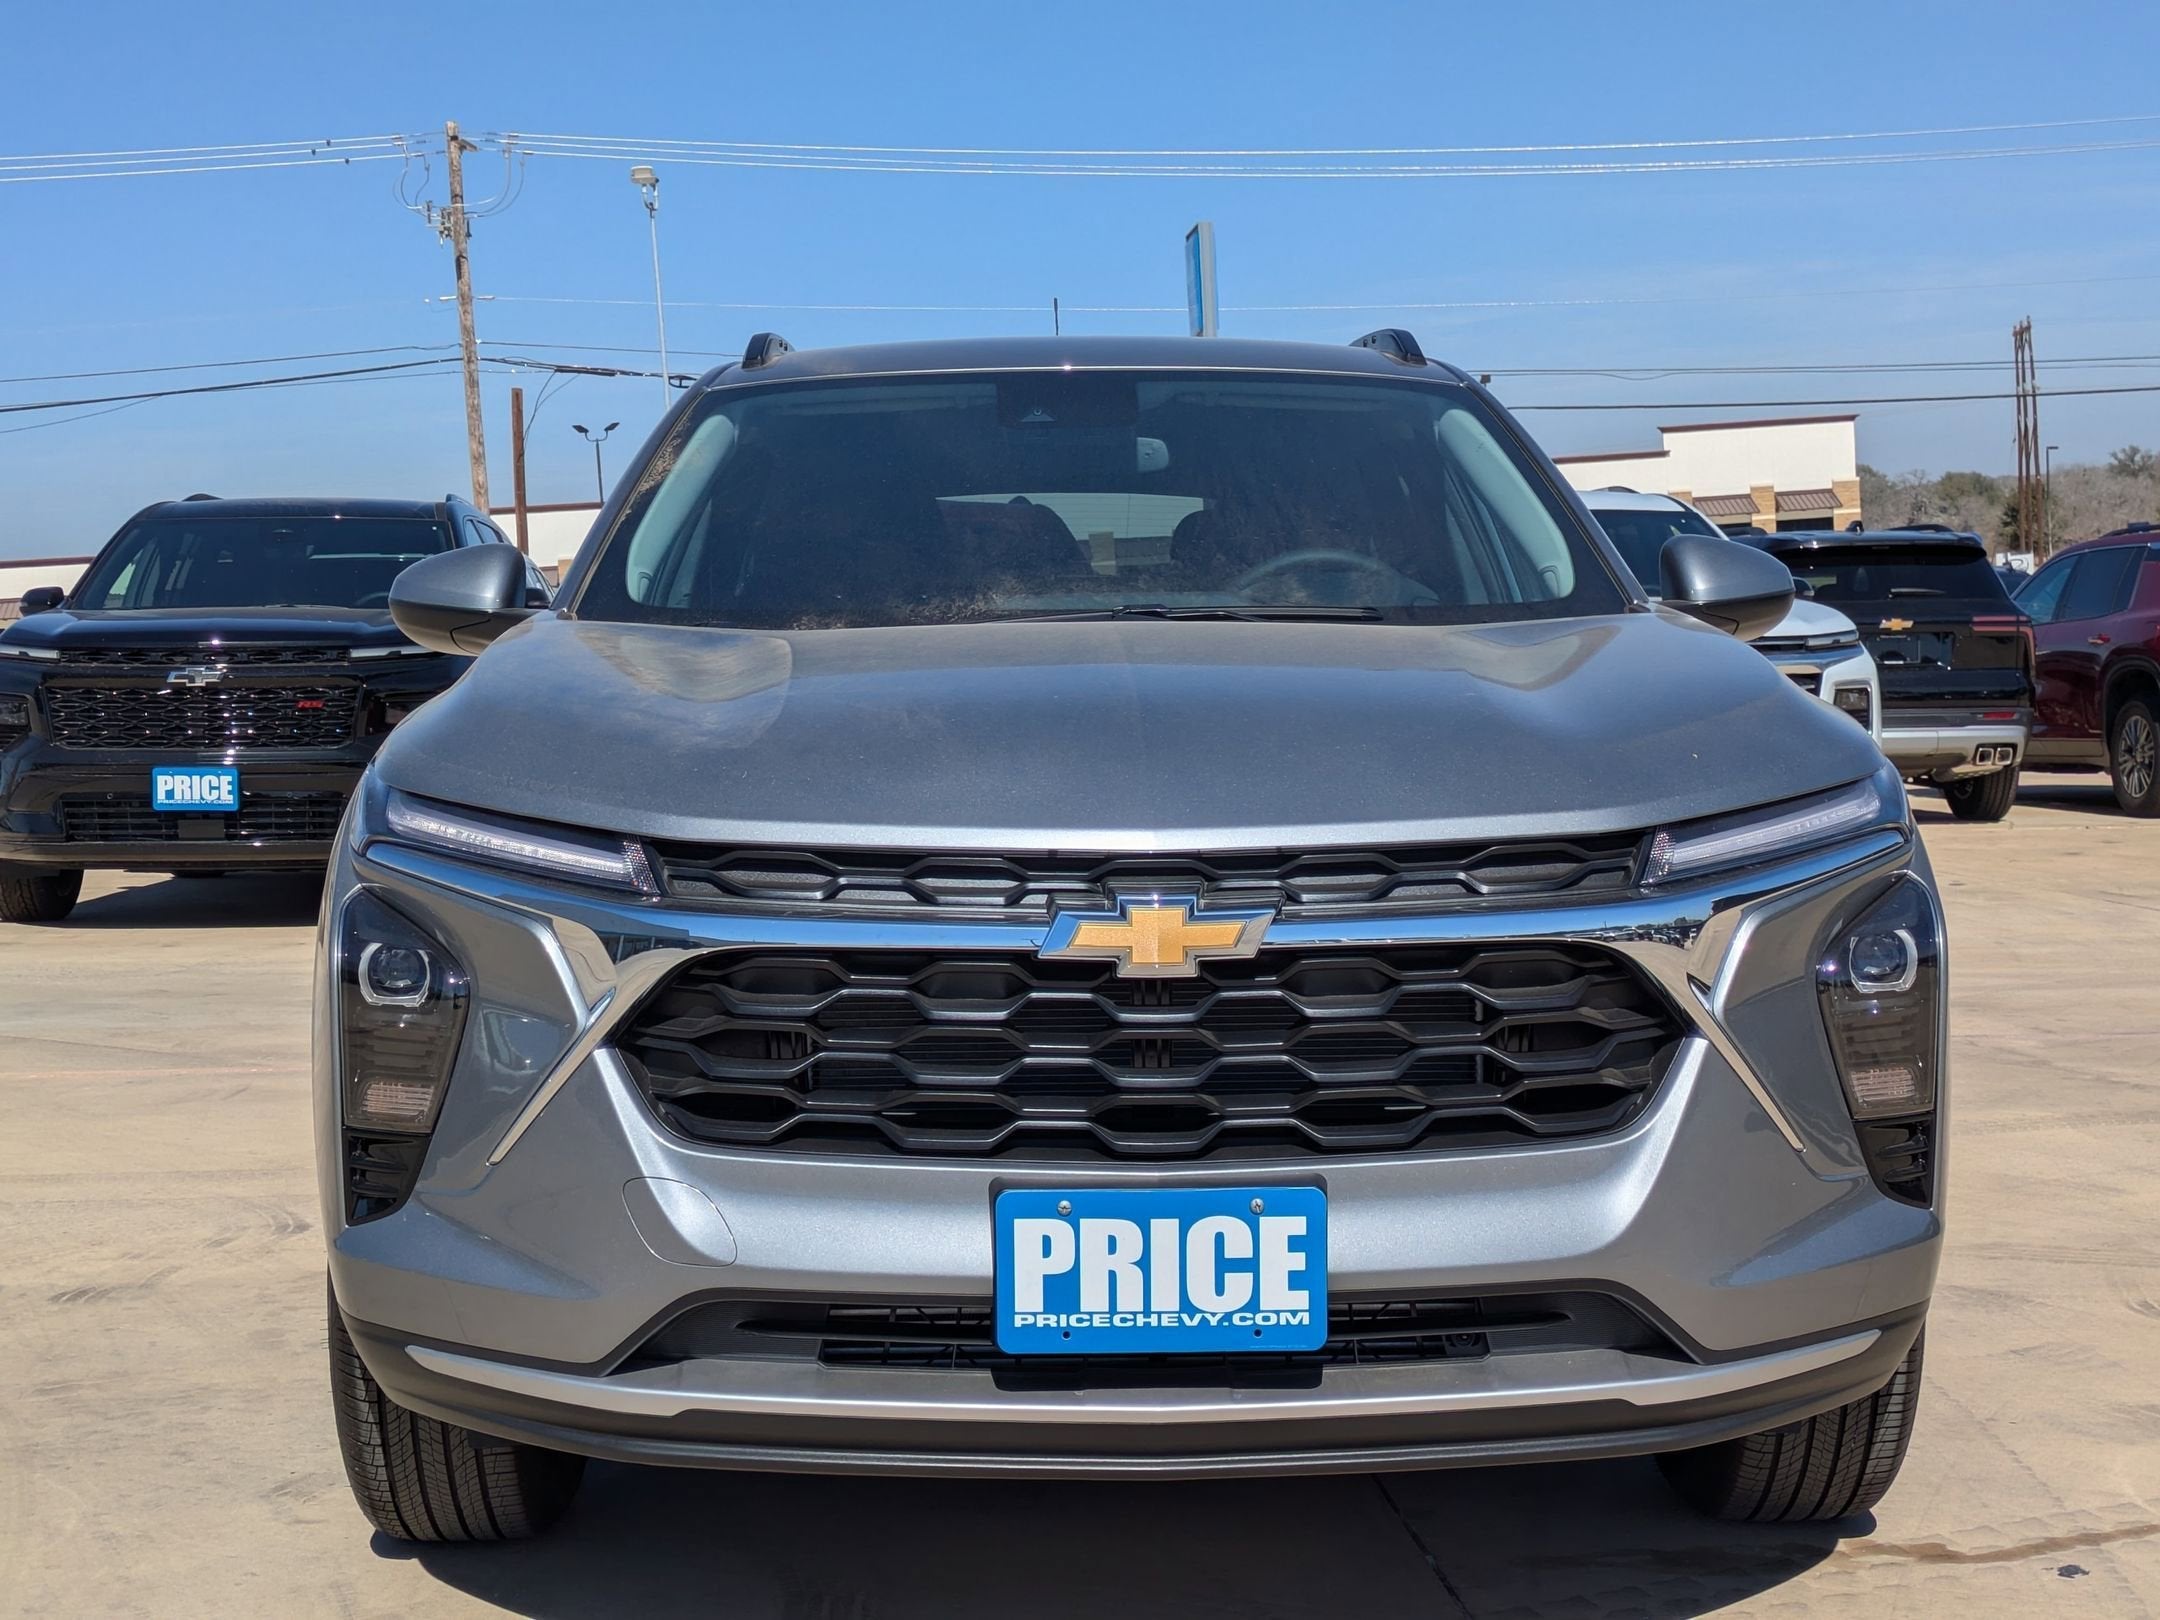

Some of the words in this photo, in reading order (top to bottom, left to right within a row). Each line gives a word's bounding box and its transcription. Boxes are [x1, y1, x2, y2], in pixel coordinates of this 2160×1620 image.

[157, 775, 234, 800] PRICE
[1013, 1215, 1310, 1313] PRICE
[1014, 1311, 1310, 1327] PRICECHEVY.COM
